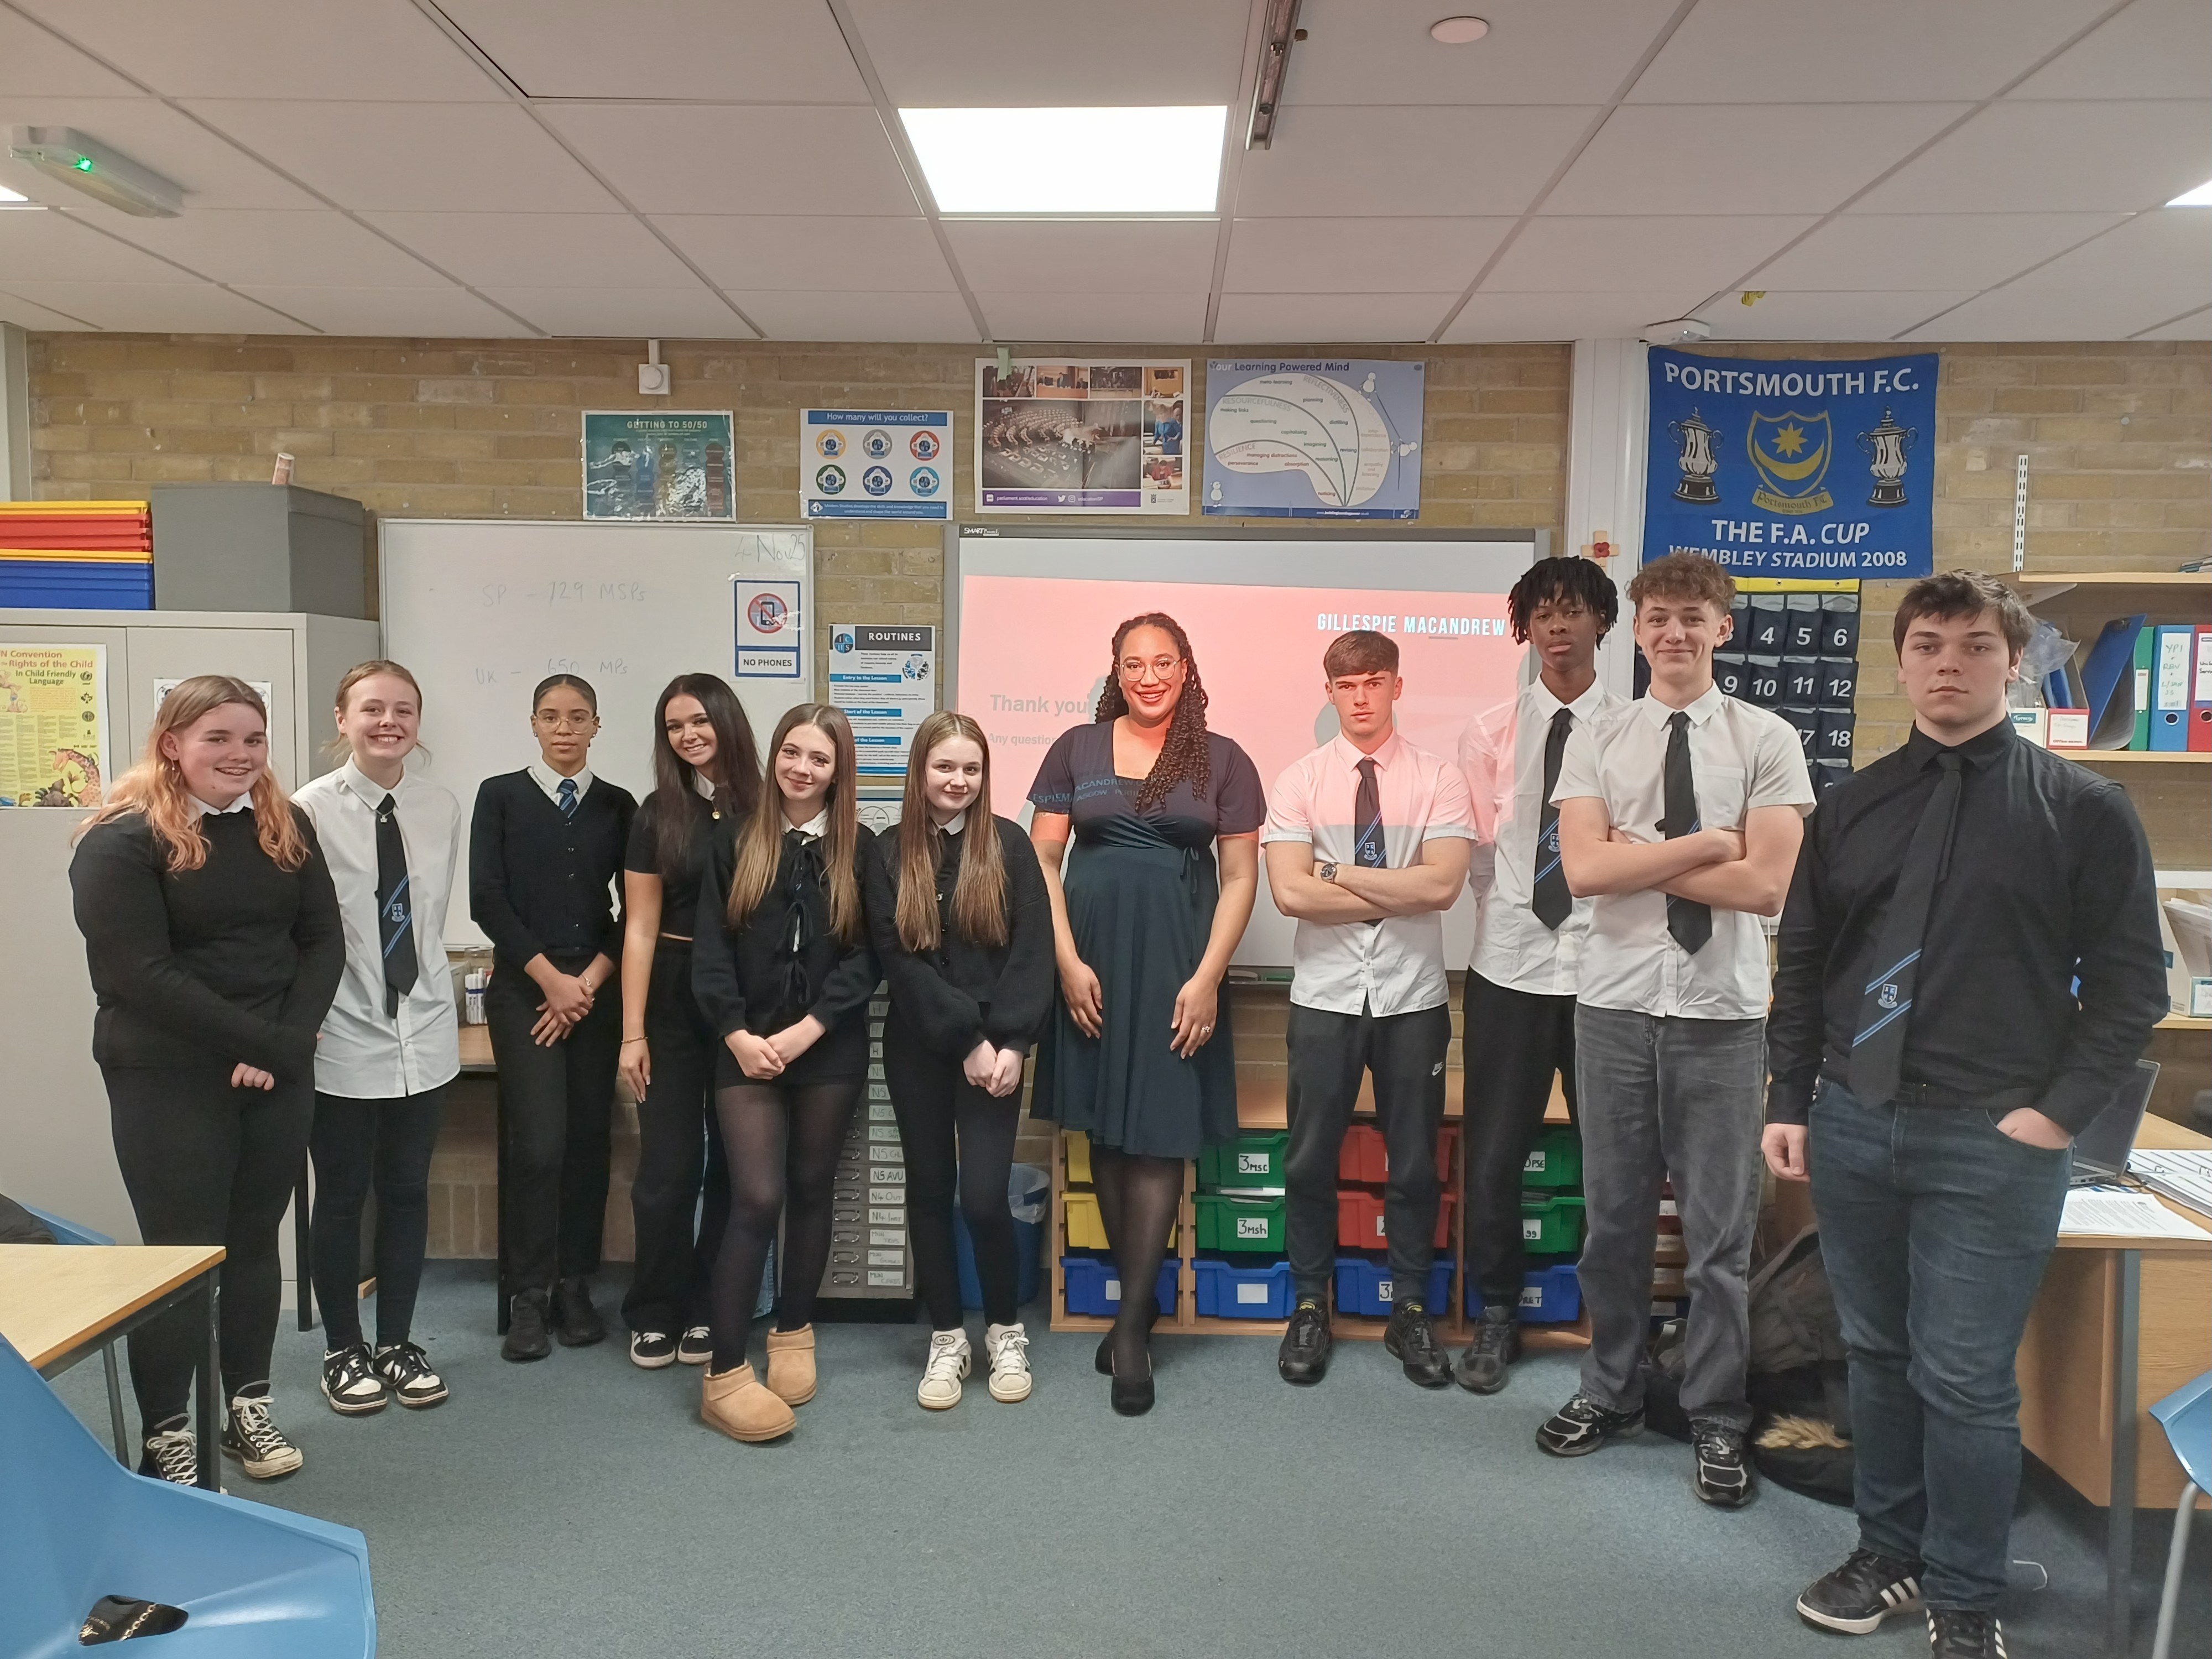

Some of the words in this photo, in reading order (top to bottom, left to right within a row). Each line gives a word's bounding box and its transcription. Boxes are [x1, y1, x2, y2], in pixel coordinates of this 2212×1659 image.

[1235, 362, 1276, 373] Learning
[1280, 362, 1322, 371] Powered
[1325, 362, 1349, 371] Mind
[1665, 362, 1864, 396] PORTSMOUTH
[1873, 368, 1919, 393] F.C.
[1303, 375, 1349, 414] REFLECTIVENESS
[1222, 397, 1292, 411] RESOURCEFULNESS
[682, 421, 708, 429] 50/50
[1218, 443, 1256, 460] RESILIENCE
[1756, 491, 1812, 509] Portsmouth
[1712, 519, 1763, 542] THE
[1771, 523, 1815, 545] F.A.
[1821, 523, 1870, 544] CUP
[1771, 551, 1856, 568] STADIUM
[1861, 551, 1907, 567] 2008
[482, 584, 506, 607] SP
[600, 582, 646, 602] MSPs
[1317, 613, 1396, 633] GILLESPIE
[1404, 615, 1505, 636] MACANDREW
[868, 633, 921, 641] ROUTINES
[1760, 627, 1775, 644] 4
[1796, 628, 1812, 645] 5
[1833, 628, 1848, 646] 6
[9, 660, 37, 669] Rights
[476, 667, 497, 685] UK
[547, 658, 580, 675] 650
[600, 658, 628, 674] MPs
[46, 670, 76, 679] Friendly
[1723, 675, 1738, 693] 9
[1752, 678, 1777, 697] 10
[1793, 676, 1814, 695] 11
[1828, 679, 1852, 697] 12
[990, 694, 1049, 713] Thank
[989, 733, 1008, 746] Any
[1828, 729, 1851, 748] 18
[873, 1148, 888, 1160] N5
[873, 1171, 885, 1181] N5
[1380, 1284, 1393, 1299] 3
